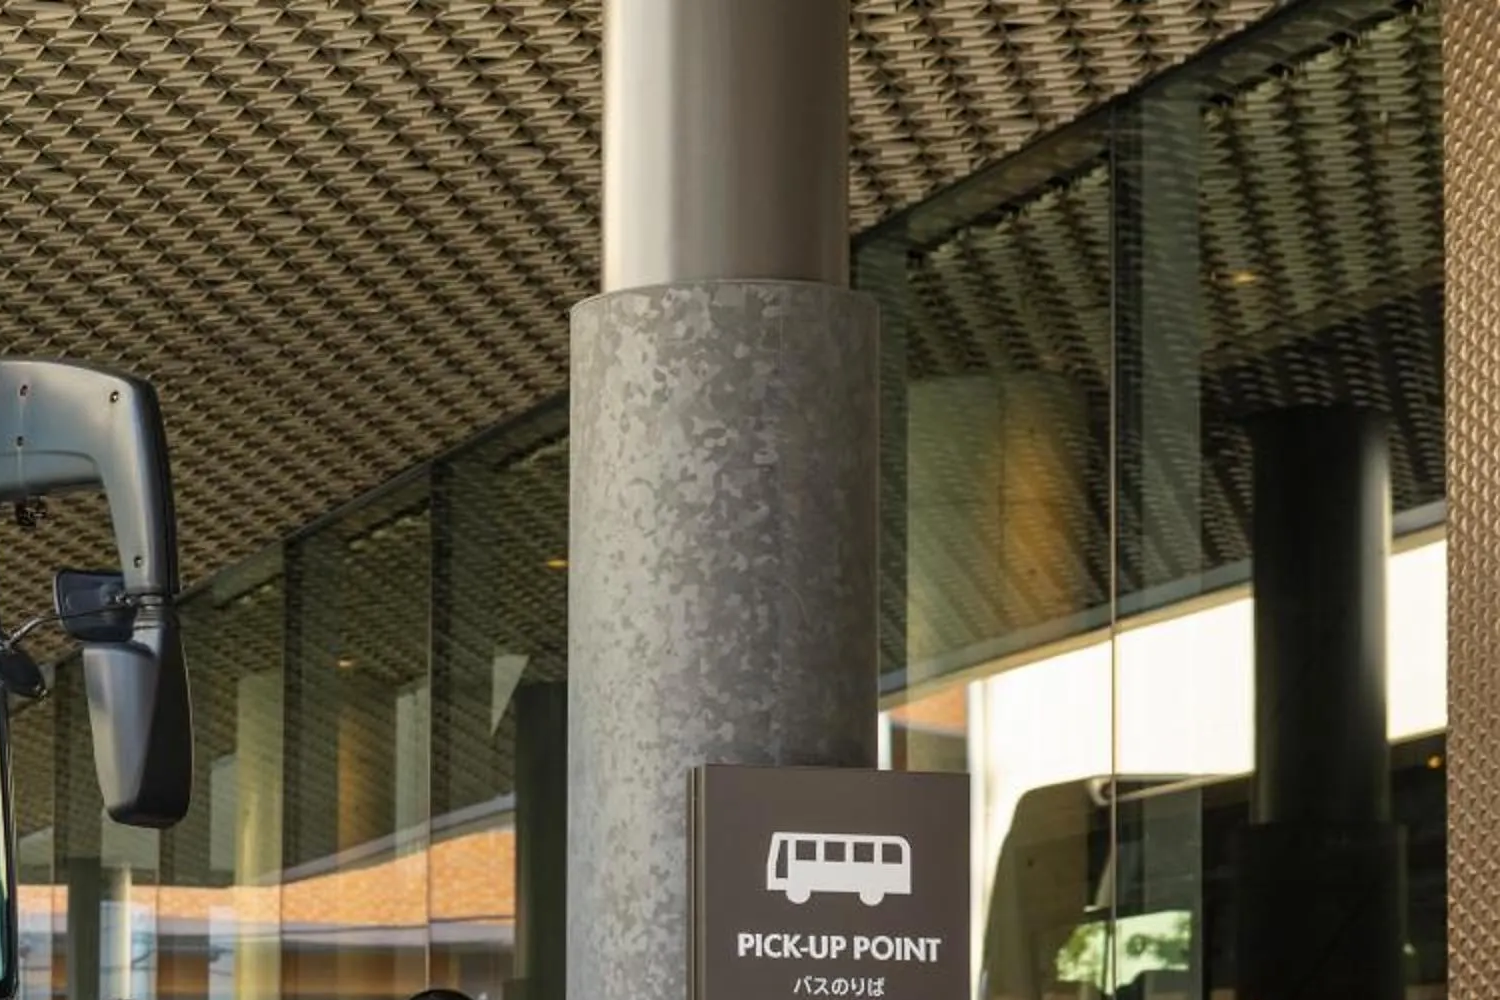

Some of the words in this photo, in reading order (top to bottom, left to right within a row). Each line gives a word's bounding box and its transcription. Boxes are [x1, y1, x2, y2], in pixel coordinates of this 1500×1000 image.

[737, 933, 846, 959] PICK-UP
[853, 936, 941, 962] POINT
[793, 976, 885, 996] バスのりば
